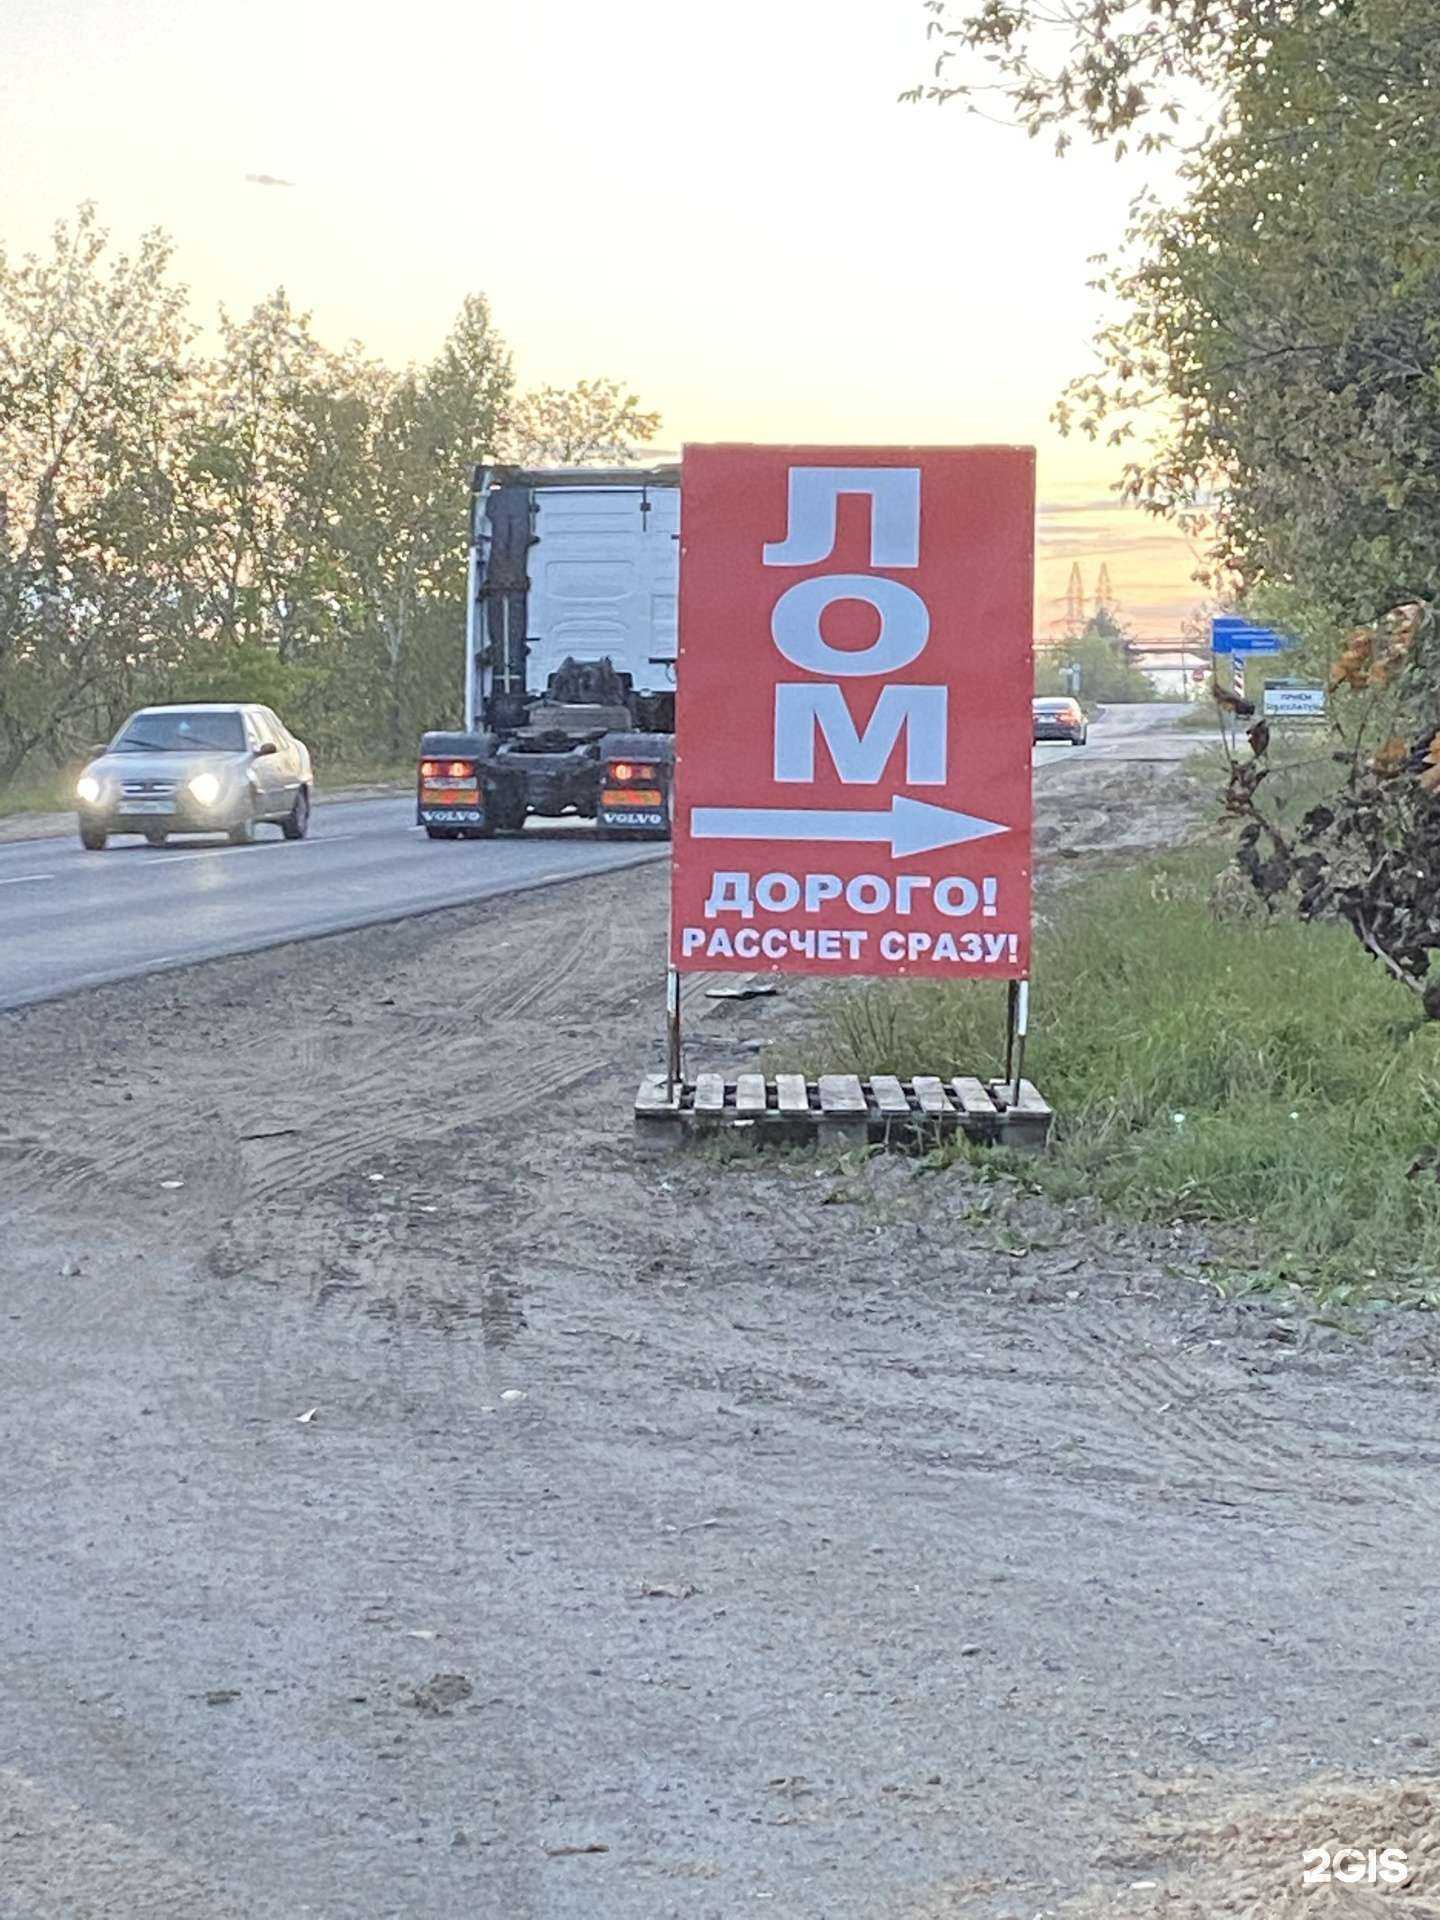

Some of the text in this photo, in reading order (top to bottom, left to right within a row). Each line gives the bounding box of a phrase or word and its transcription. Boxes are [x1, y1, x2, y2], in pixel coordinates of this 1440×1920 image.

[763, 466, 949, 786] ЛОМ
[421, 810, 480, 821] VOLVO
[604, 813, 661, 824] VOLVO
[704, 871, 998, 919] ДОРОГО!
[682, 927, 1018, 964] РАССЧЕТ СРАЗУ!
